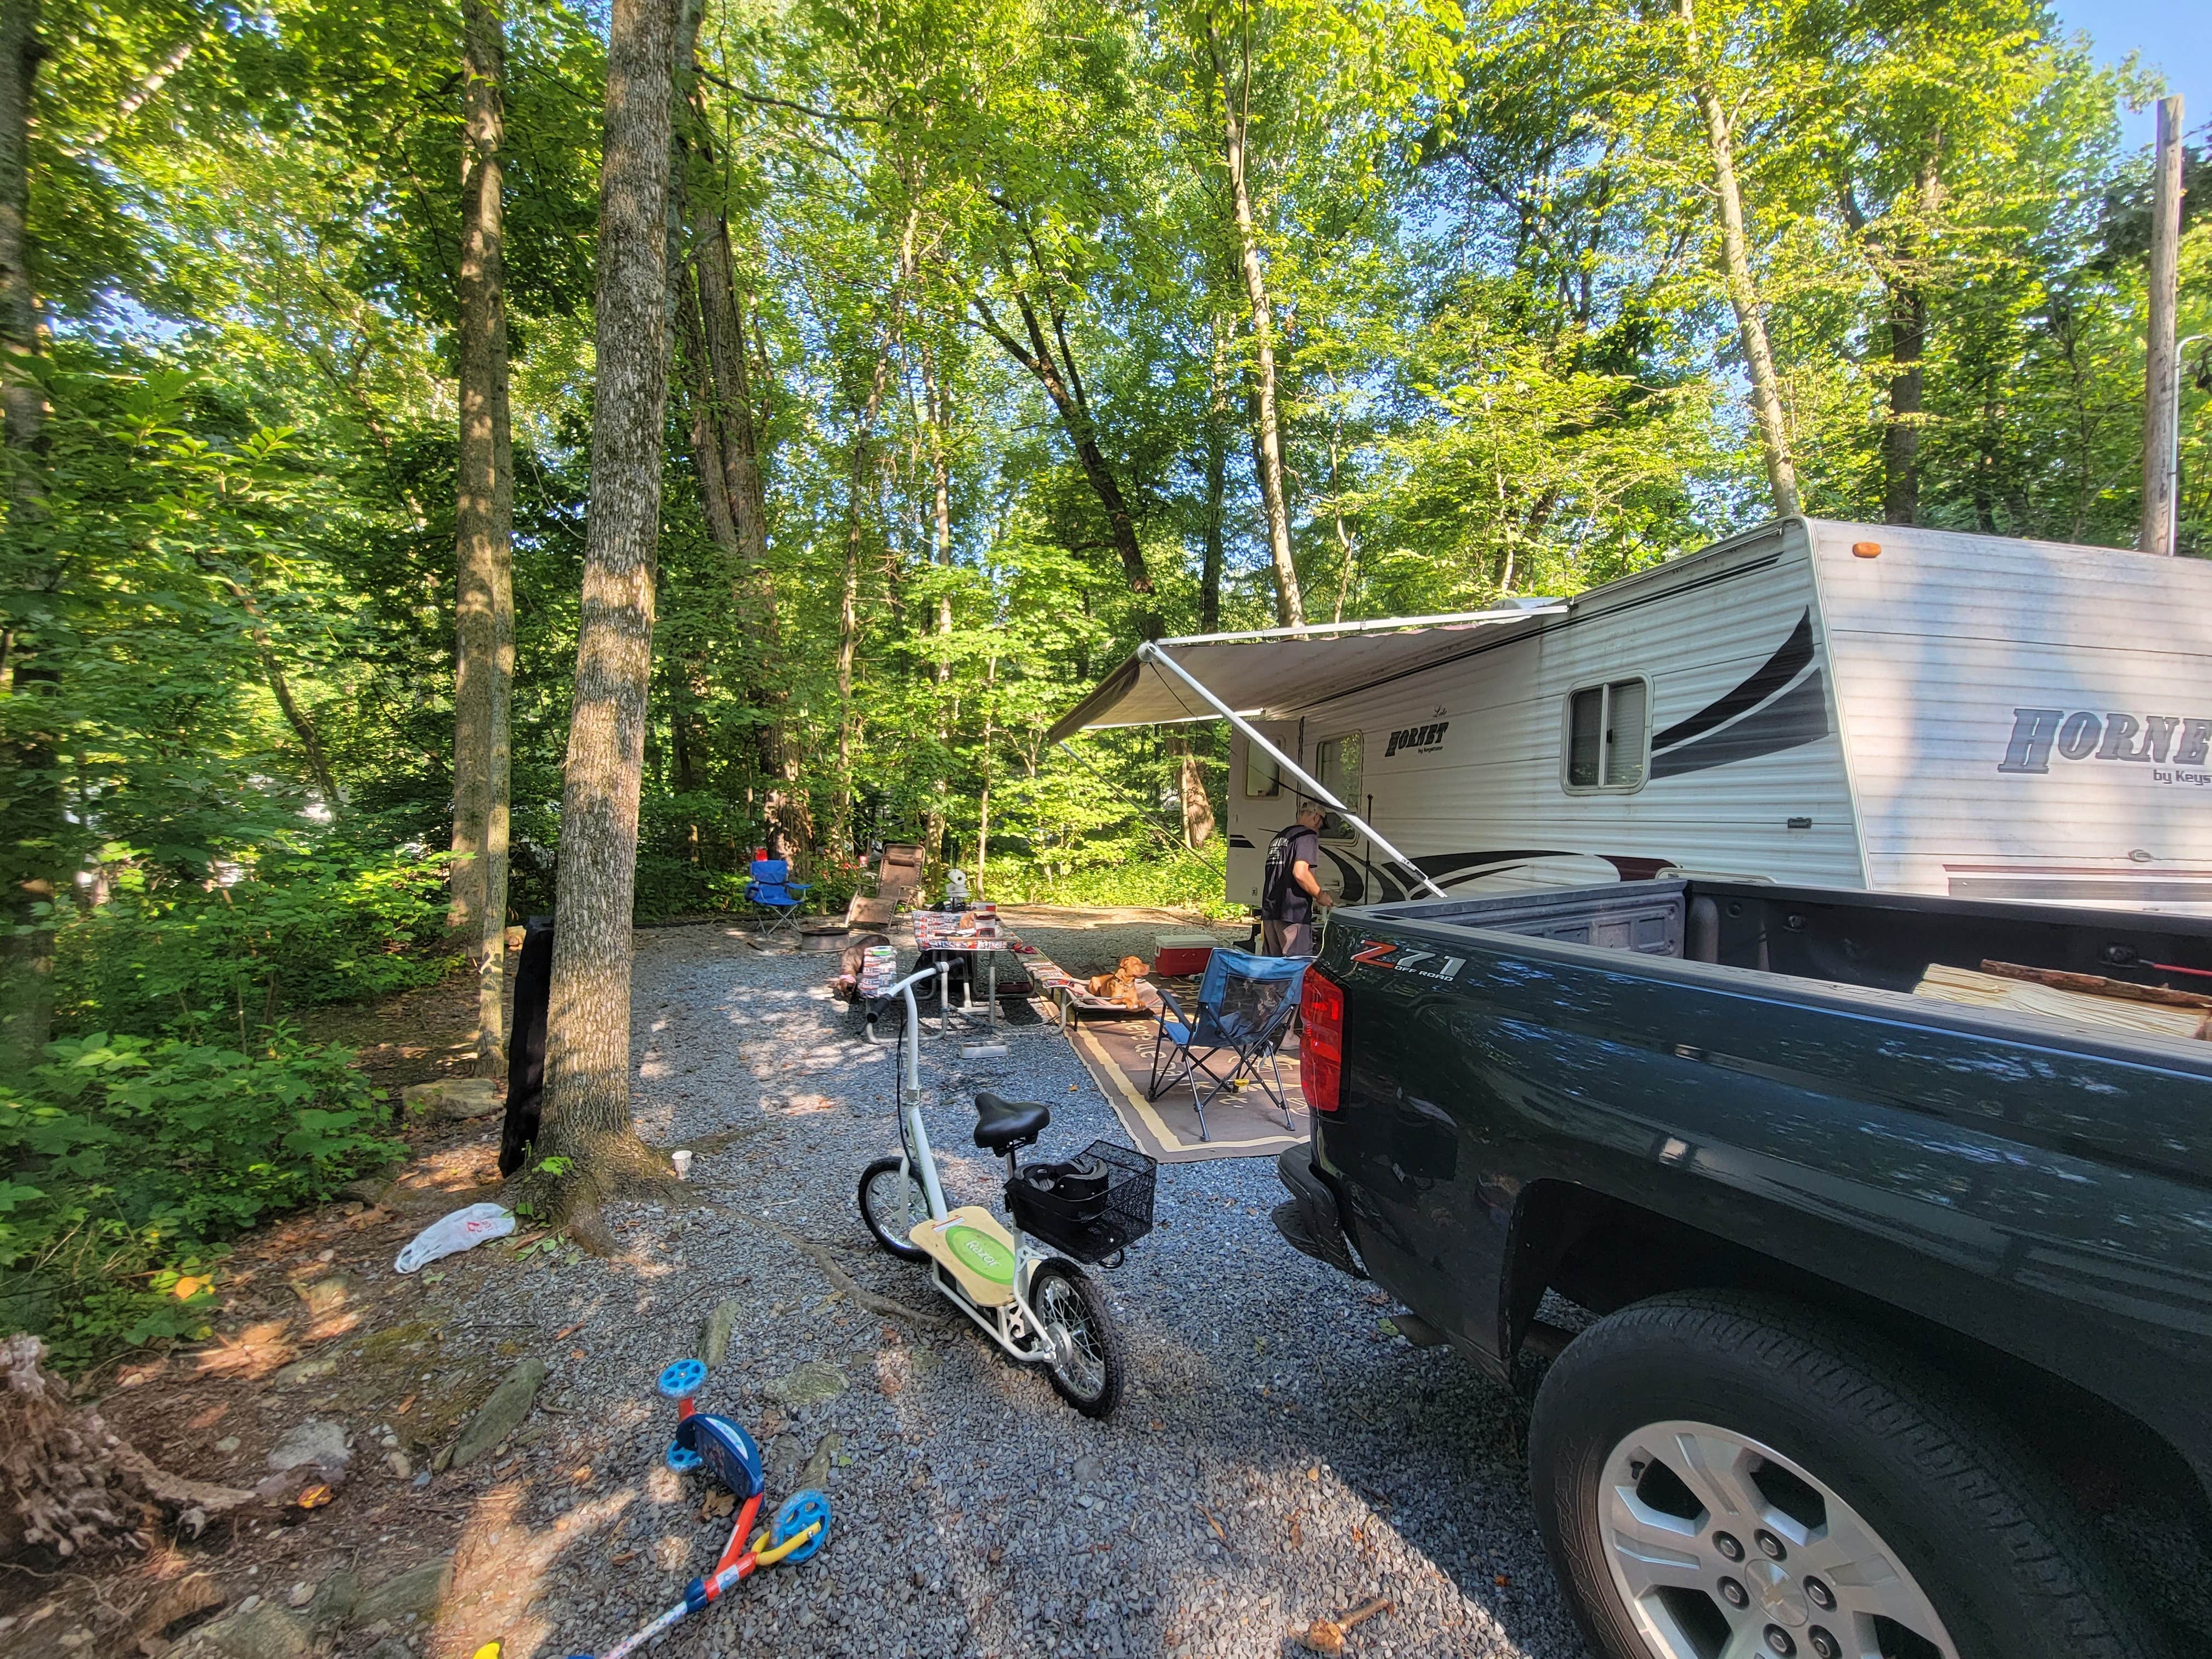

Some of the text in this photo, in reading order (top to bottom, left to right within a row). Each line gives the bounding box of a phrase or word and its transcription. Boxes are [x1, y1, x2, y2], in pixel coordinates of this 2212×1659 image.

[1997, 708, 2212, 774] HORNE
[2153, 769, 2211, 786] by Keys
[1350, 940, 1466, 977] Z71
[1394, 965, 1454, 981] OFF ROAD
[966, 1240, 1001, 1267] Razor
